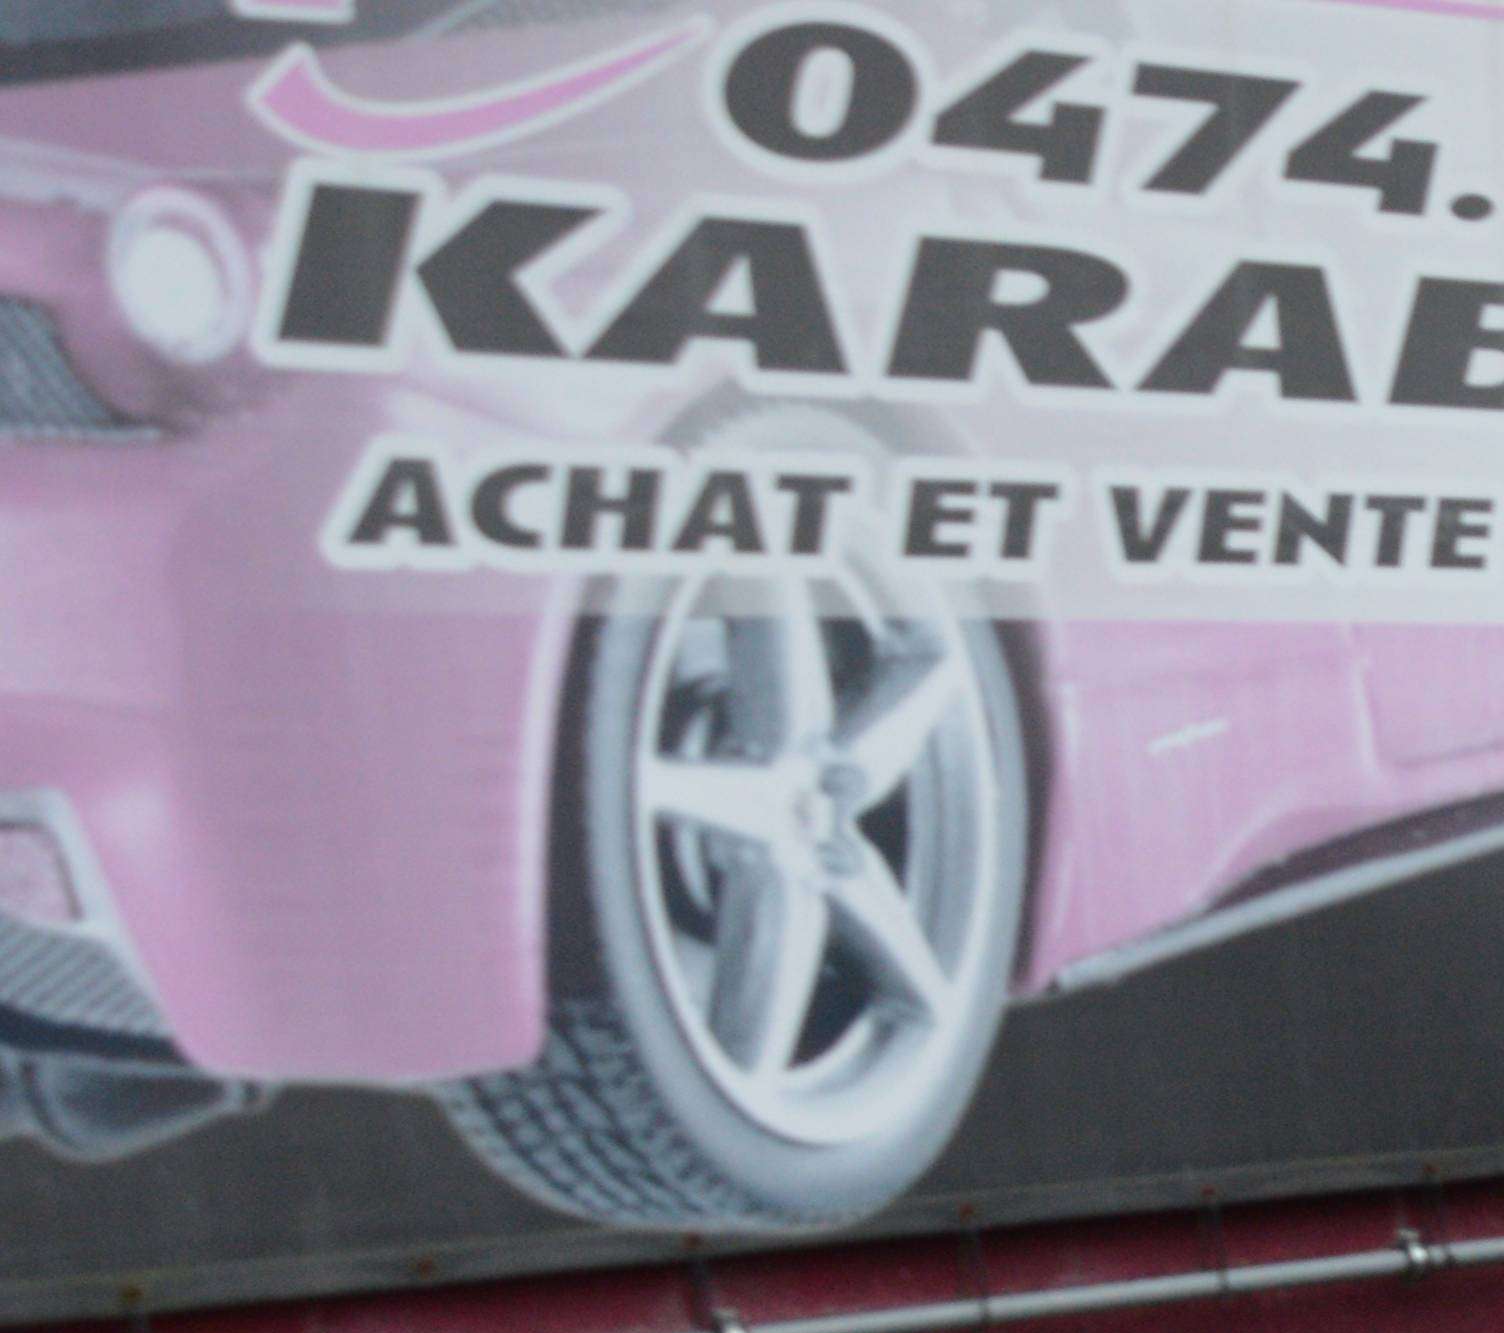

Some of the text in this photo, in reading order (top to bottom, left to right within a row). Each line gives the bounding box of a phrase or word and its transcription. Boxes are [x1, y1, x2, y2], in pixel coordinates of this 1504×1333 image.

[349, 458, 851, 554] ACHAT
[901, 480, 1060, 560] ET
[1110, 486, 1490, 569] VENTE
